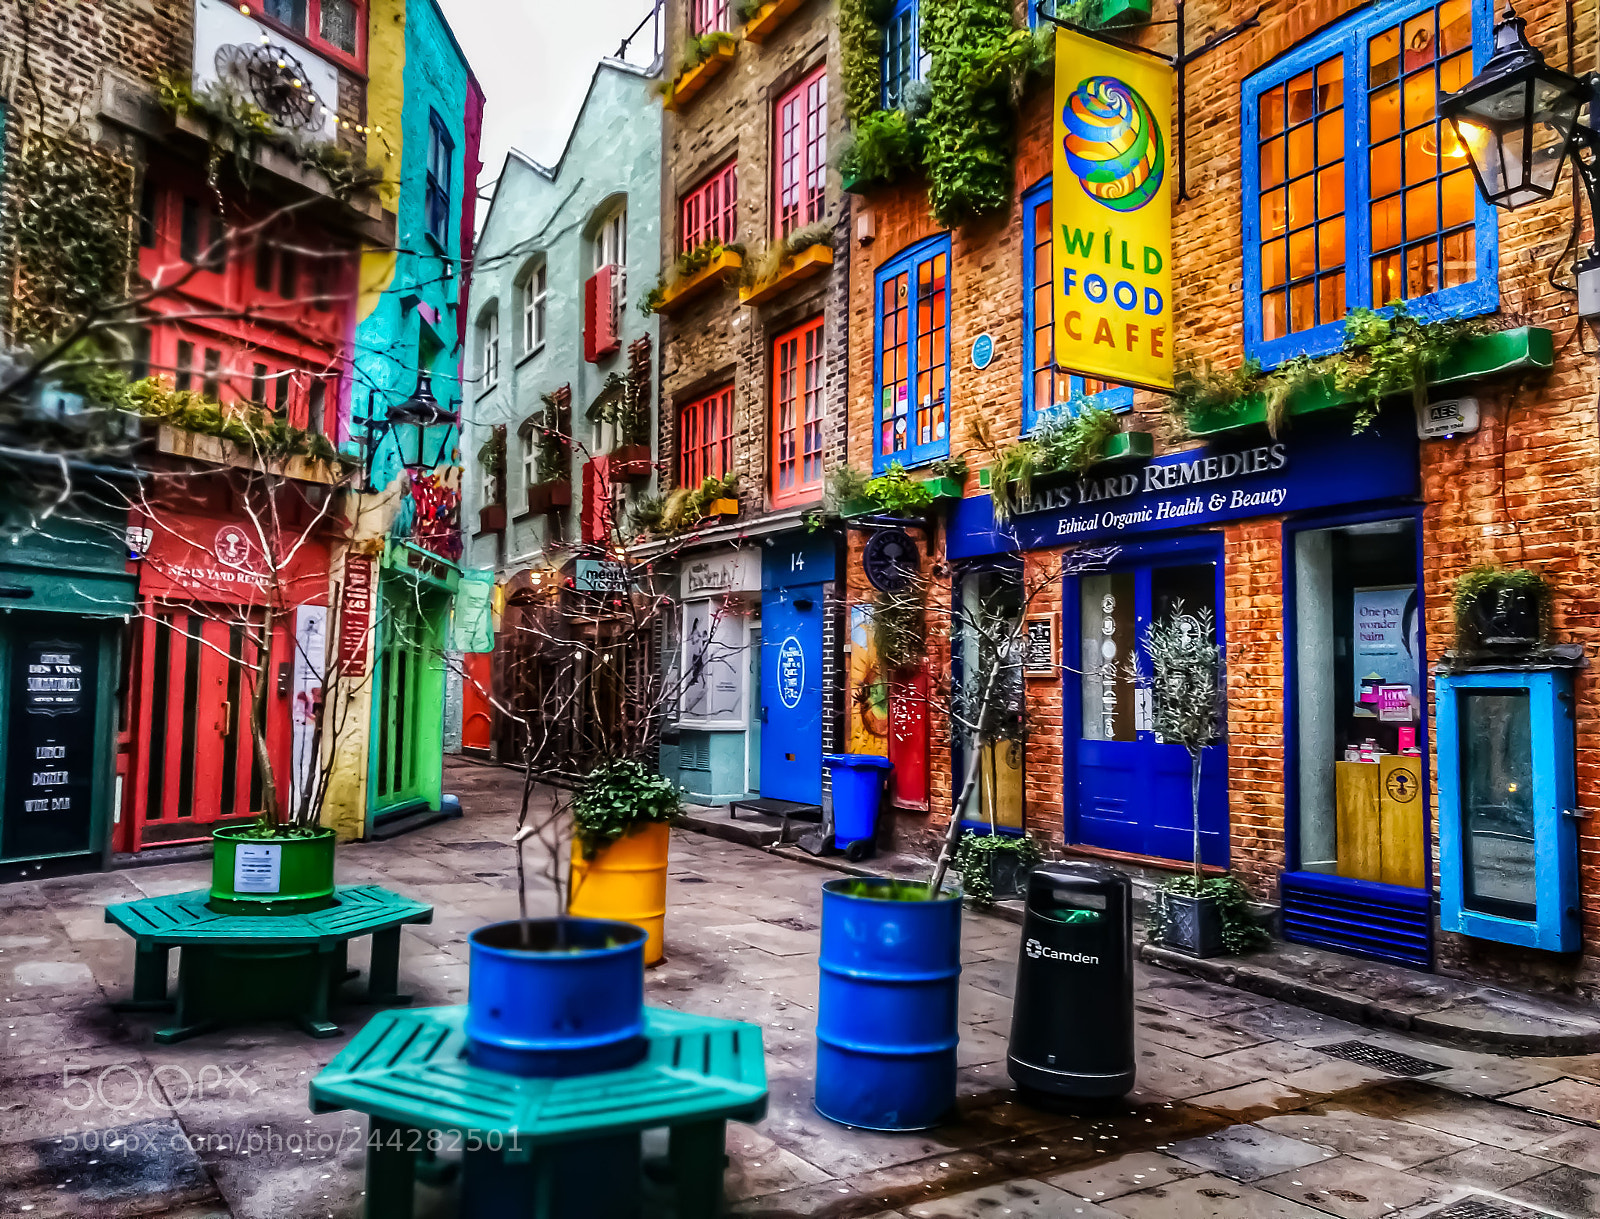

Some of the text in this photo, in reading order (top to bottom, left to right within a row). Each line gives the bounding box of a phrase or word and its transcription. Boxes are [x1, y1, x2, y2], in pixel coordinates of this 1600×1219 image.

[1062, 224, 1163, 275] WILD
[1063, 267, 1164, 316] FOOD
[1432, 404, 1458, 419] AES
[1077, 474, 1140, 504] YARD
[1142, 443, 1287, 493] REMEDIES
[1056, 488, 1287, 535] Ethical Organic Health & Beauty
[790, 551, 805, 572] 14
[1359, 606, 1400, 618] One pot
[1359, 619, 1398, 629] wonder
[1042, 946, 1099, 965] Camden
